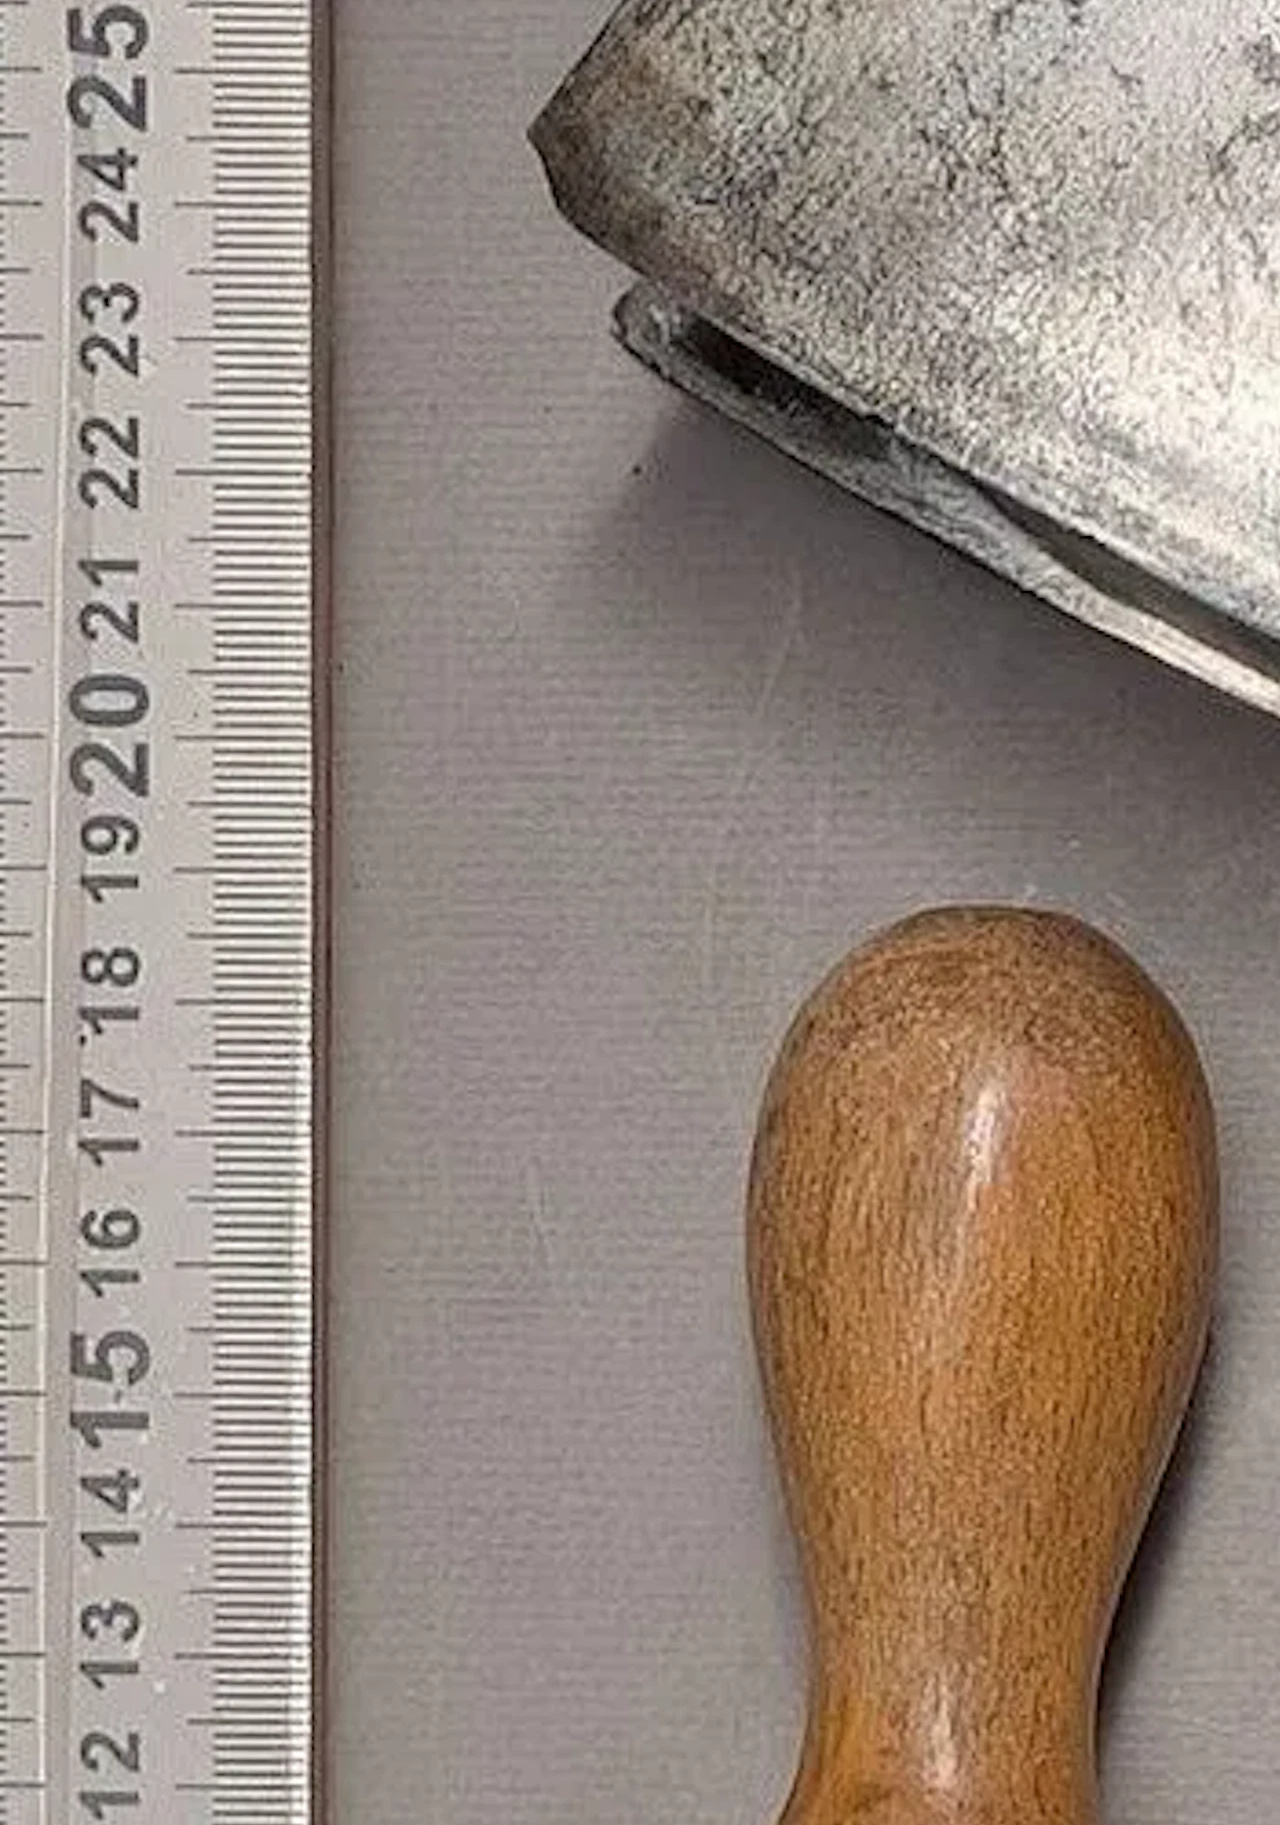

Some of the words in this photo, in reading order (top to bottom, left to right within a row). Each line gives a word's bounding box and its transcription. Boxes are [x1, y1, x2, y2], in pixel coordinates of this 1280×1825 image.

[66, 4, 149, 133] 25
[76, 147, 139, 244] 24
[77, 282, 140, 378] 23
[77, 417, 139, 510] 22
[77, 558, 140, 644] 21
[67, 674, 150, 798] 20
[78, 815, 140, 904] 19
[77, 947, 141, 1036] 18
[76, 1077, 141, 1168] 17
[78, 1209, 141, 1298] 16
[68, 1330, 151, 1450] 15
[79, 1468, 141, 1559] 14
[78, 1600, 141, 1690] 13
[78, 1731, 141, 1821] 12
